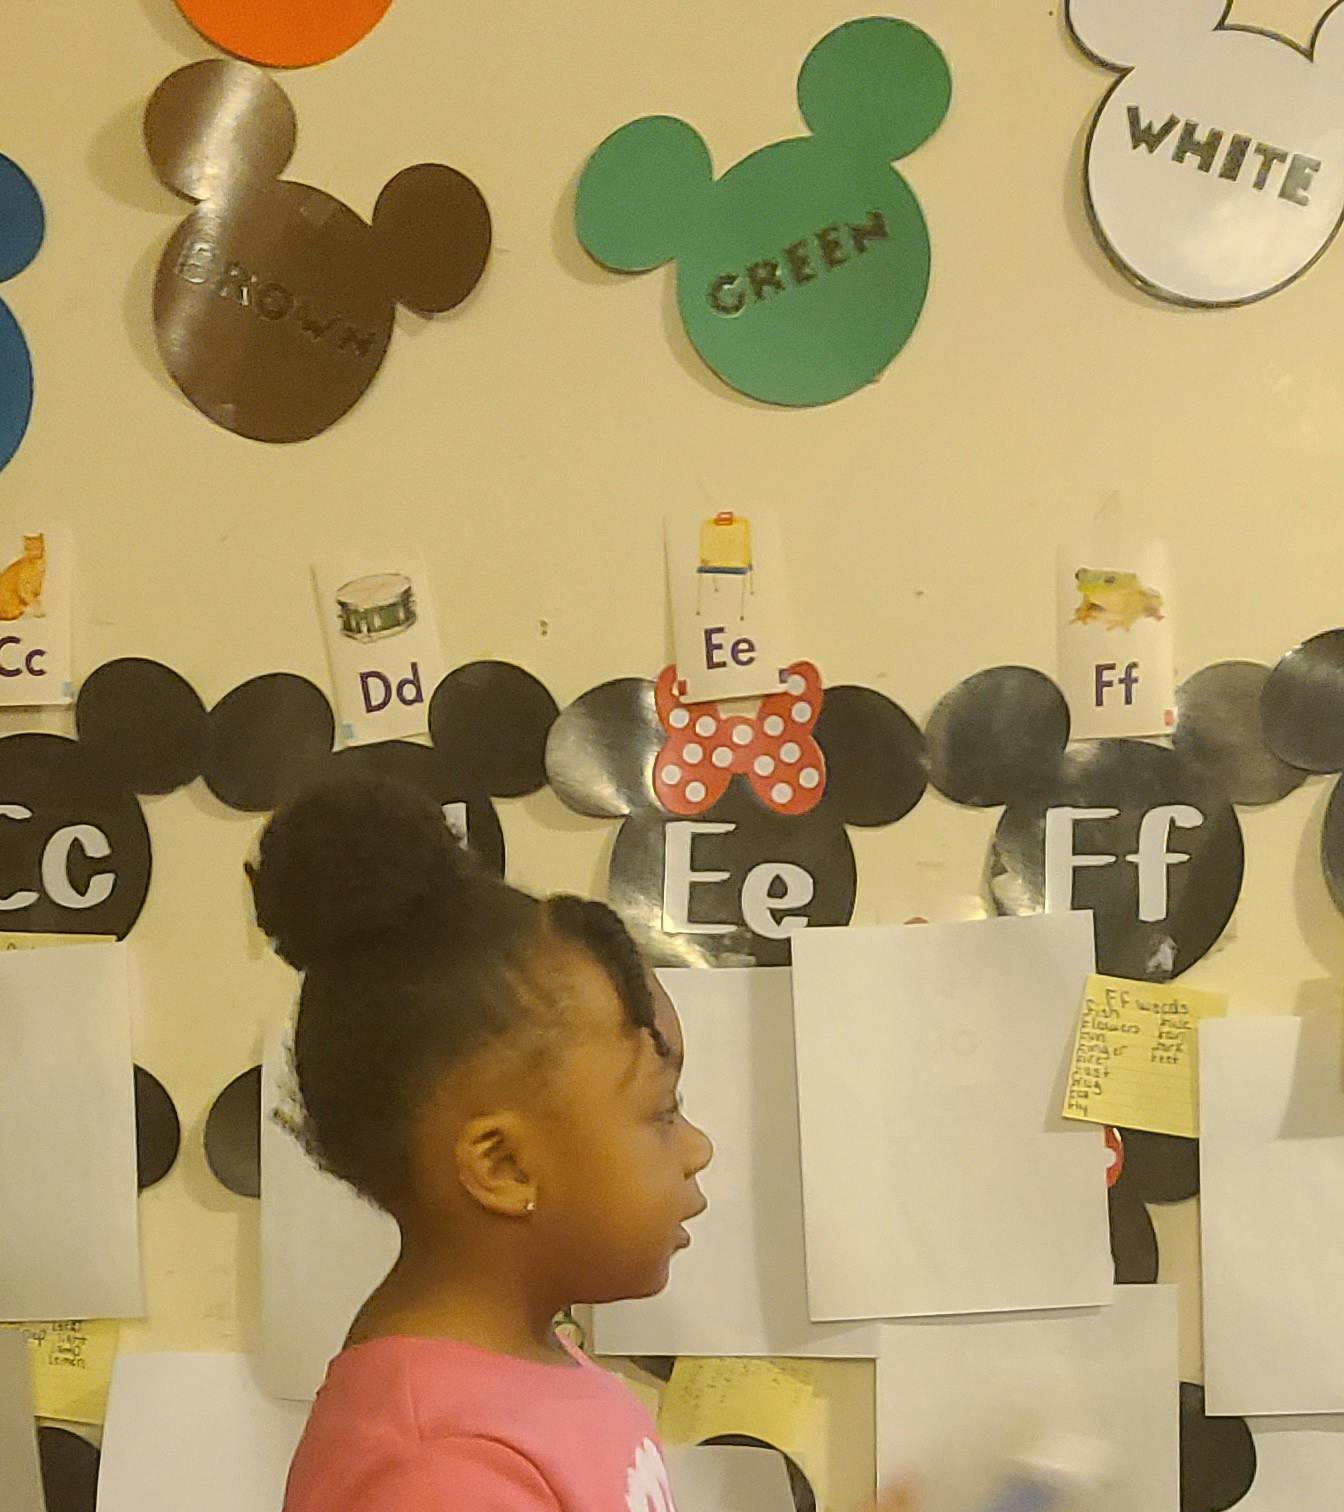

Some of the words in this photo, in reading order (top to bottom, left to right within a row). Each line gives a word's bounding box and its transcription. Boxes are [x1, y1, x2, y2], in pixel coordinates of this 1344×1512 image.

[1124, 103, 1322, 208] WHITE
[176, 241, 378, 358] BROWN
[707, 209, 890, 318] GREEN
[359, 663, 424, 714] Dd
[704, 626, 757, 670] Ee
[1094, 662, 1139, 707] Ff
[660, 820, 815, 939] Ee
[1044, 805, 1205, 923] Ff
